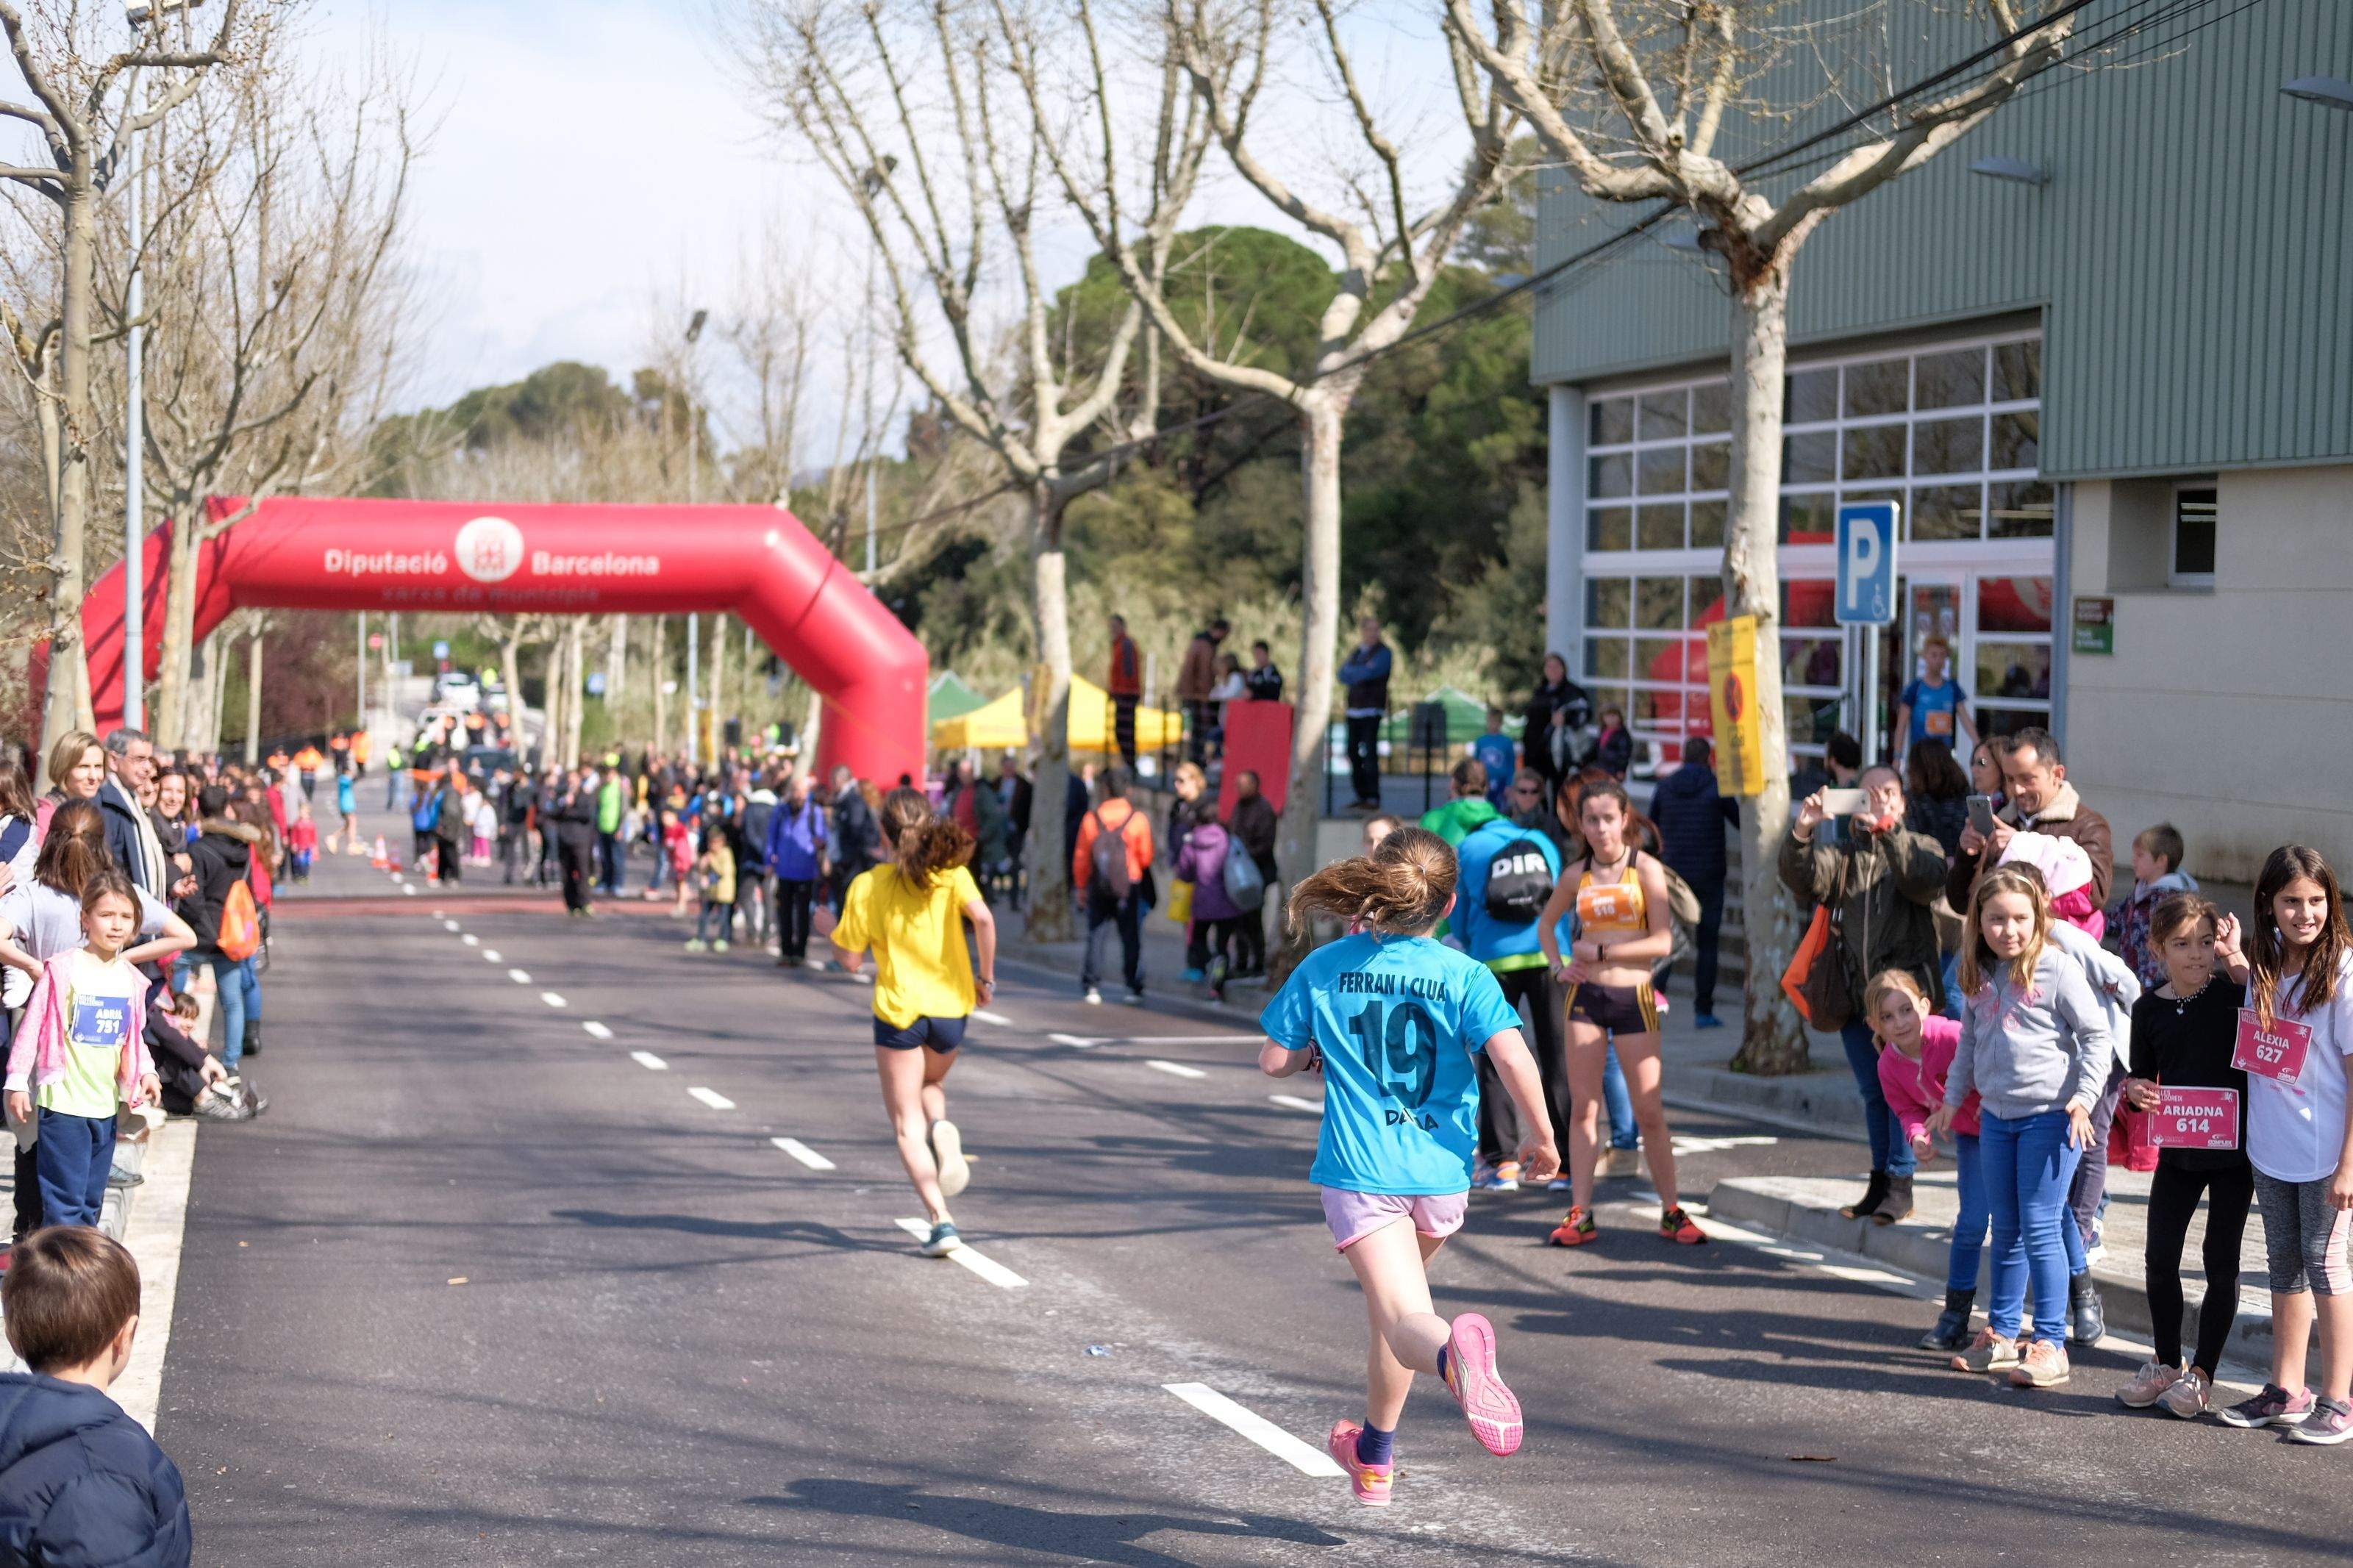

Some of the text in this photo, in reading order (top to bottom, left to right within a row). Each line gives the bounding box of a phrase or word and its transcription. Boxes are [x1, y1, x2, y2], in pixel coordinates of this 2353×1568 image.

[324, 548, 660, 578] Diputació Barcelona
[1846, 518, 1881, 610] P
[1491, 853, 1547, 878] DIR
[1338, 972, 1446, 1002] FERRAN I CLUA
[96, 1019, 121, 1034] 751
[2253, 1030, 2290, 1050] ALEXIA
[1349, 1000, 1438, 1109] 19
[2256, 1045, 2283, 1064] 627
[1385, 1108, 1439, 1132] DAA
[2163, 1105, 2224, 1117] ARIADNA
[2176, 1118, 2210, 1133] 614
